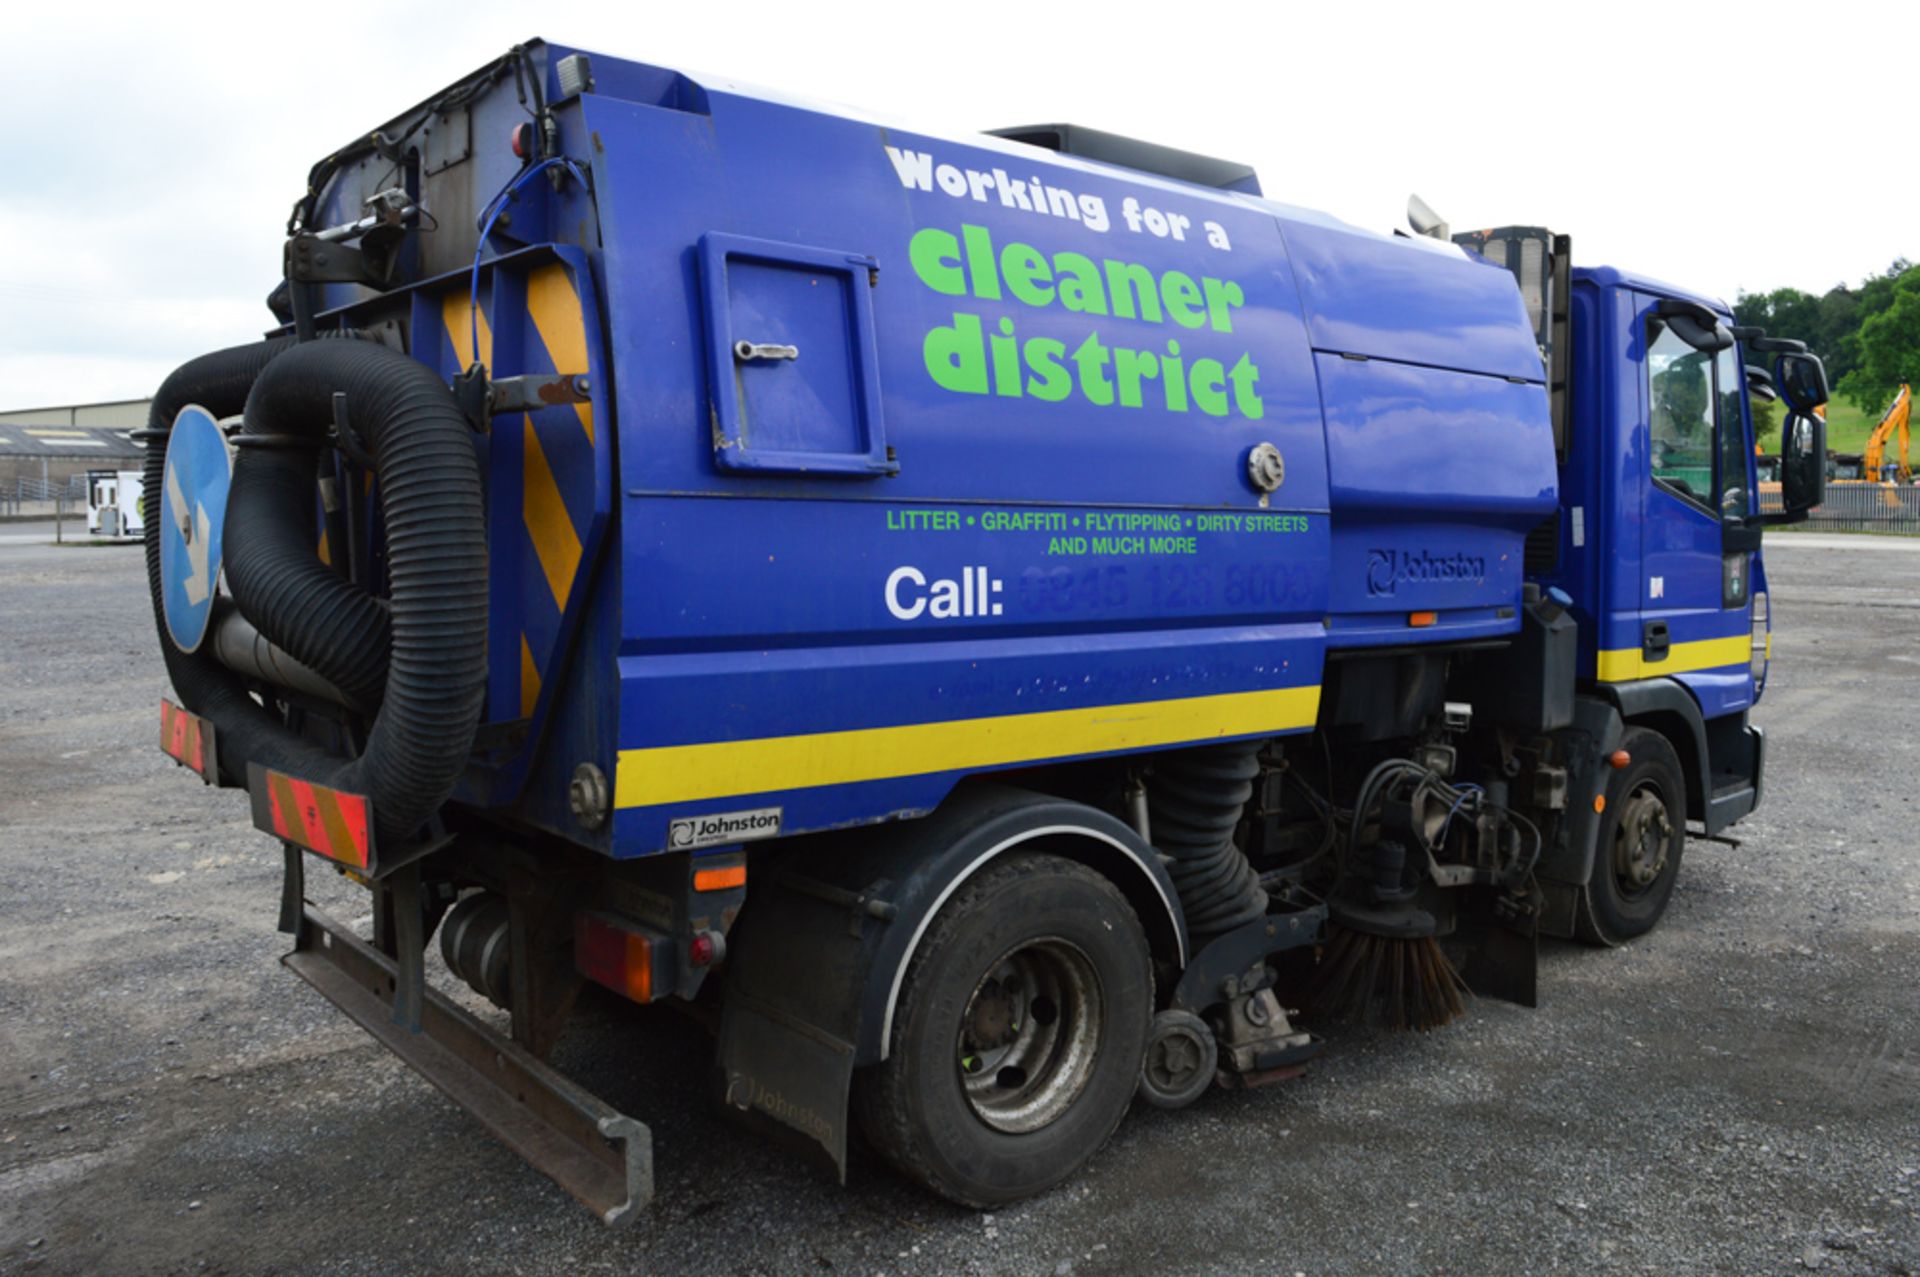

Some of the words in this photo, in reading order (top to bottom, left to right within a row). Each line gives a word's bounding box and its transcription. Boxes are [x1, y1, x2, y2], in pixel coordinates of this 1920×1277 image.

[884, 145, 1110, 232] Working
[1122, 197, 1191, 241] for
[1204, 220, 1232, 251] a
[909, 223, 1244, 334] cleaner
[923, 312, 1264, 420] district
[887, 510, 960, 530] LITTER
[981, 512, 1067, 531] GRAFFITI
[1085, 514, 1181, 532] FLYTIPPING
[1197, 514, 1242, 532] DIRTY
[1246, 516, 1309, 532] STREETS
[1048, 537, 1088, 555] AND
[1091, 537, 1145, 555] MUCH
[1149, 537, 1197, 554] MORE
[1395, 549, 1486, 580] Johnston
[885, 566, 1003, 619] Call:
[697, 815, 779, 836] Johnston
[754, 1083, 834, 1140] Johnston
